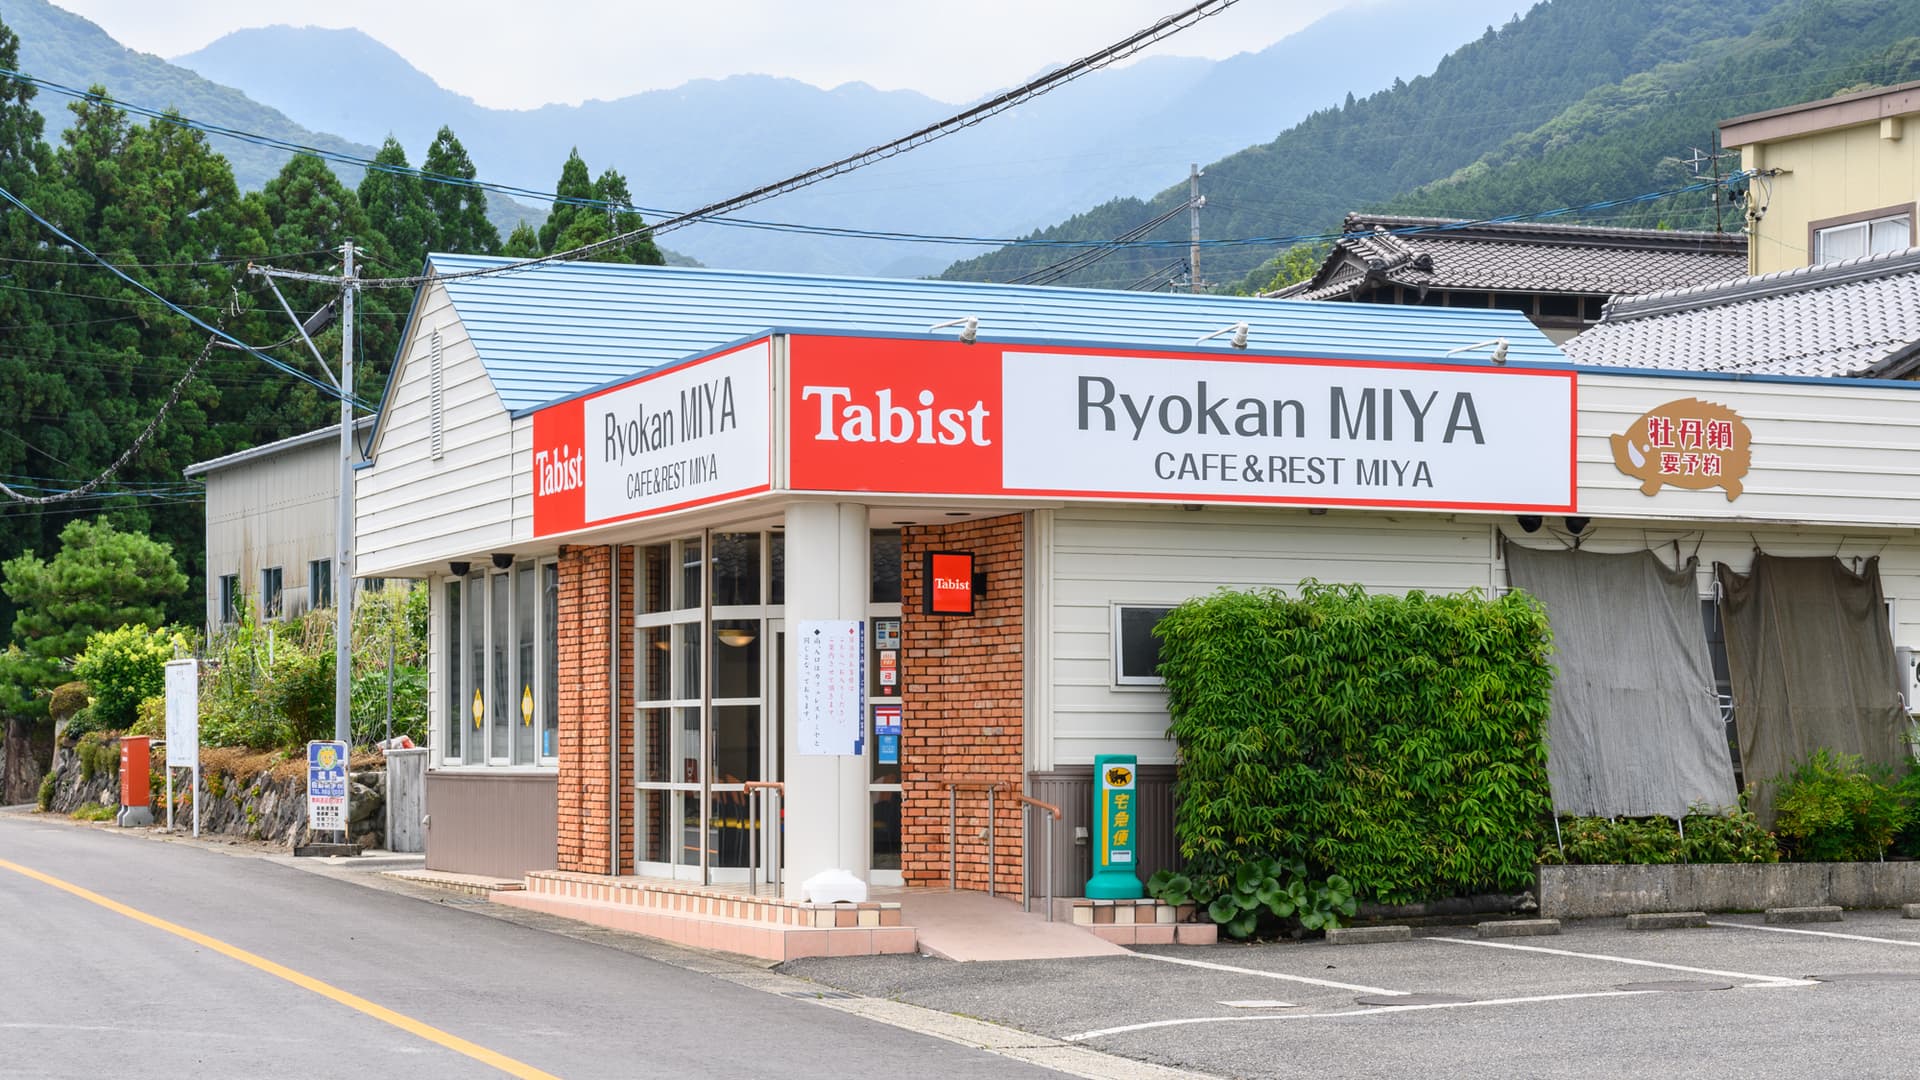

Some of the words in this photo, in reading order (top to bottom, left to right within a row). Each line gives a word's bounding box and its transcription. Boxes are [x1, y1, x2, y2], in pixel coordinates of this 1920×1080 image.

[605, 403, 674, 467] Ryokan
[681, 375, 737, 443] MIYA
[801, 385, 992, 447] Tabist
[1077, 375, 1306, 441] Ryokan
[1330, 386, 1486, 445] MIYA
[1648, 417, 1733, 450] 牡丹鍋
[536, 444, 584, 497] Tabist
[626, 460, 687, 500] CAFE&REST
[690, 453, 718, 487] MIYA
[1154, 451, 1346, 485] CAFE&REST
[1356, 458, 1434, 489] MIYA
[1661, 453, 1722, 476] 要予約
[934, 577, 970, 591] Tabist
[1113, 793, 1130, 847] 宅急便
